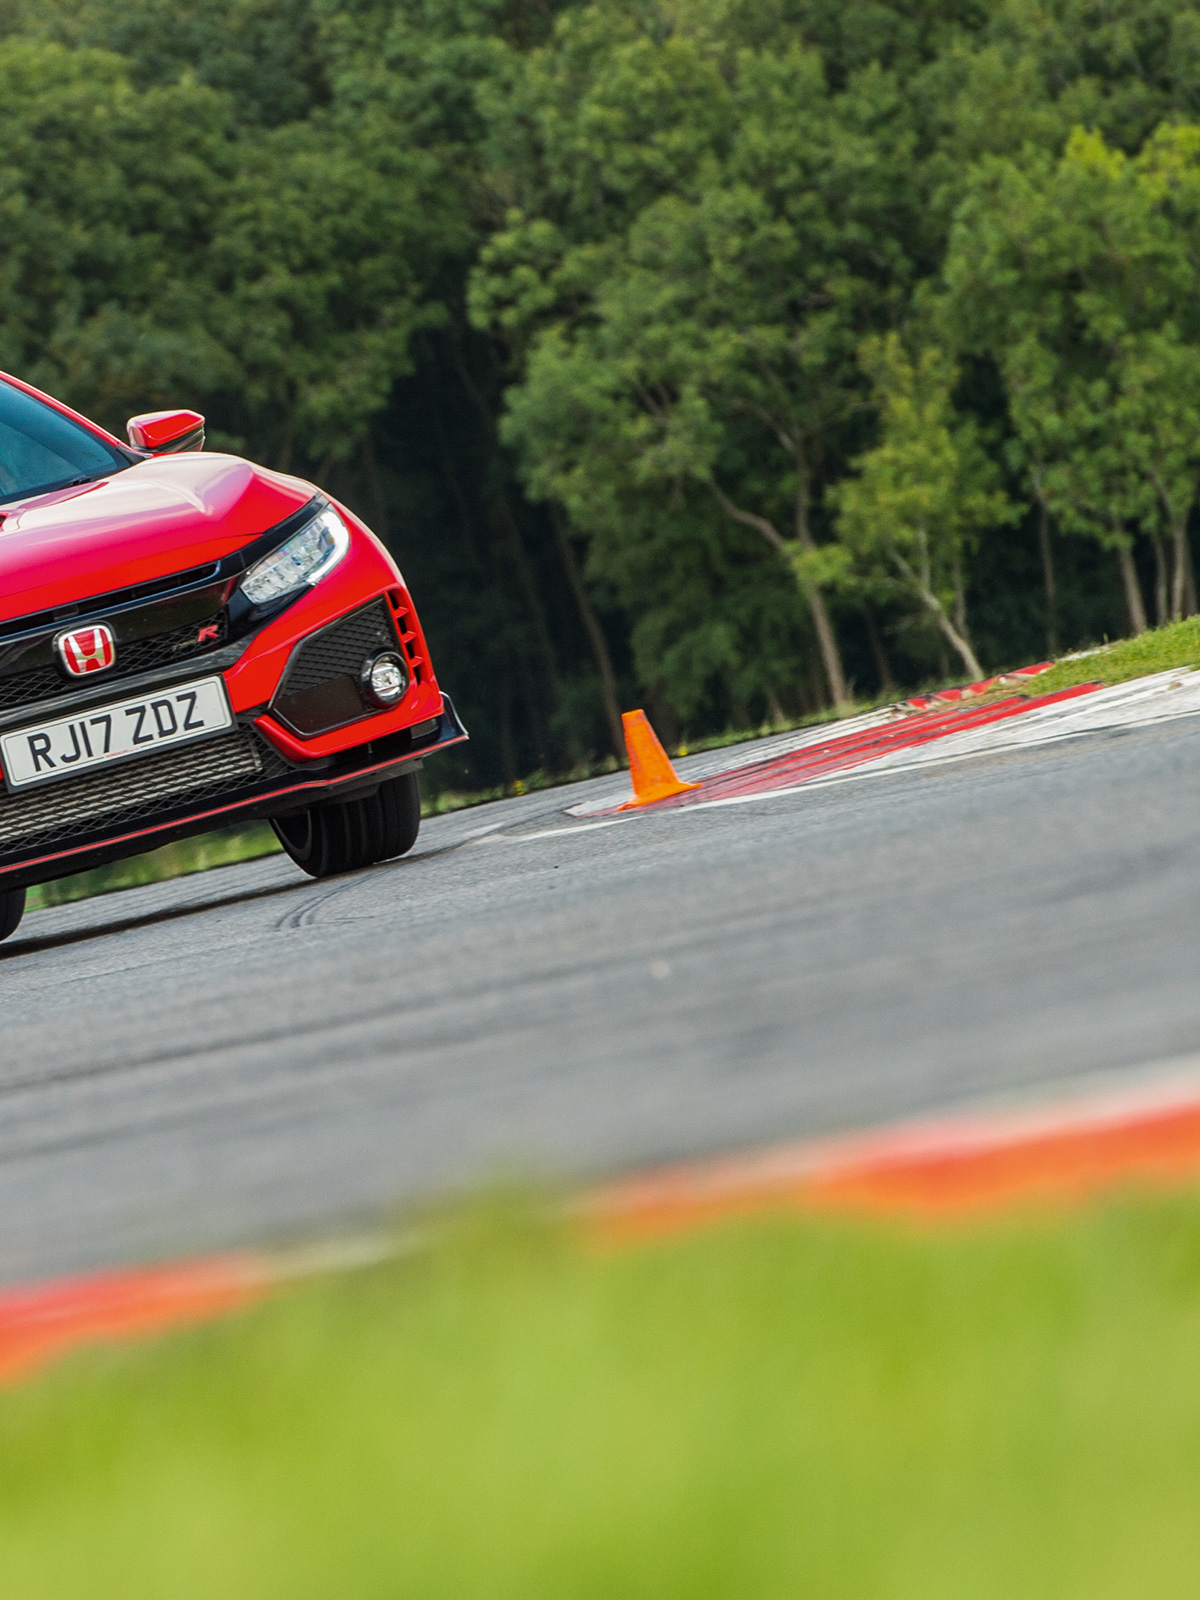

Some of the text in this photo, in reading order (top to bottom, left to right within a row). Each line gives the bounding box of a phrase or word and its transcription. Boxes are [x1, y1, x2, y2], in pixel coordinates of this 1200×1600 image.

[198, 624, 218, 642] R
[27, 691, 205, 772] RJ17 ZDZ
